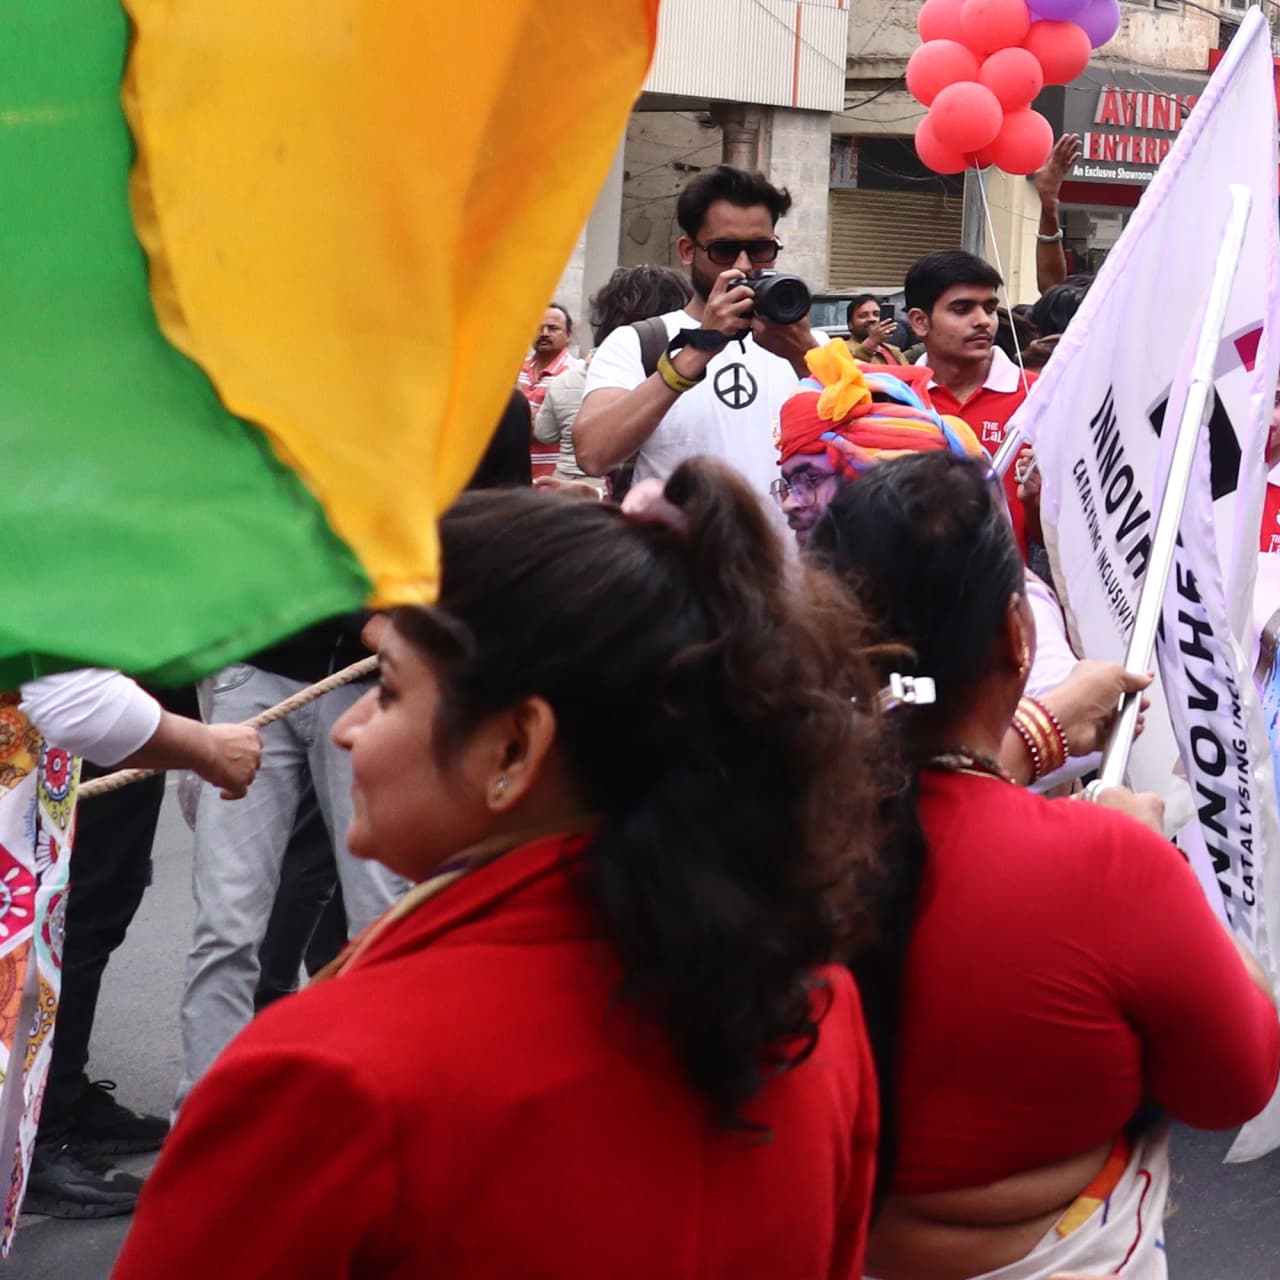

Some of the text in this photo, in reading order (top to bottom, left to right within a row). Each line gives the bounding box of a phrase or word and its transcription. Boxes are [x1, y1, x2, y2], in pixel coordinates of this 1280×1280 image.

[1072, 164, 1153, 181] An Exclusive Showroom
[1072, 457, 1103, 552] CATALYSING
[1232, 738, 1256, 907] CATALYSING
